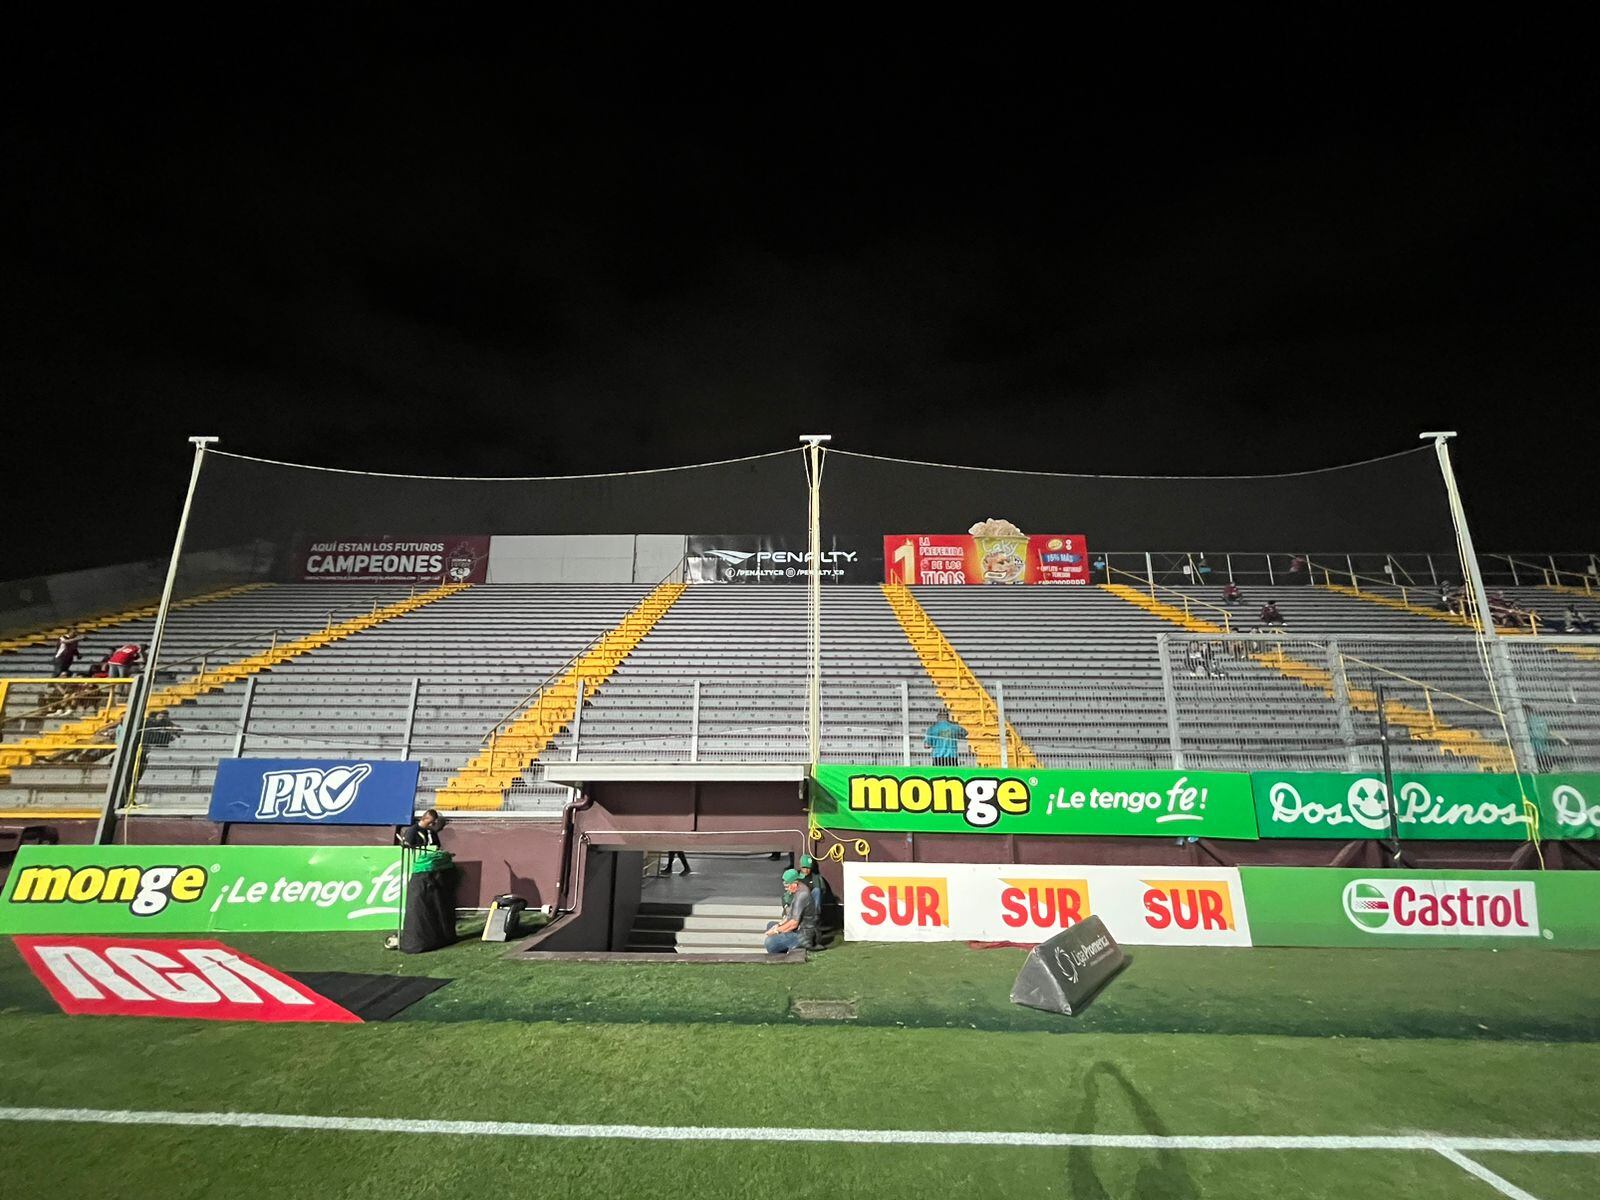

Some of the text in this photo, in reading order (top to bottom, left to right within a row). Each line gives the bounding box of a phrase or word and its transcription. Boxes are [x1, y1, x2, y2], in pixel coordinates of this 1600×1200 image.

[372, 542, 394, 552] LOS
[394, 542, 445, 552] FUTUROS
[919, 536, 931, 546] LA
[919, 547, 964, 556] PREFERIDA
[306, 555, 443, 573] CAMPEONES
[920, 571, 965, 584] TICOS
[931, 561, 962, 570] DE LOS
[256, 764, 371, 819] PRO
[850, 776, 1029, 826] monge
[1089, 789, 1161, 814] tengo
[1269, 782, 1534, 825] Dos Pinos
[12, 864, 208, 916] monge
[271, 877, 363, 908] tengo
[860, 886, 940, 927] SUR
[1001, 887, 1082, 928] SUR
[1393, 885, 1529, 928] Castrol
[1143, 889, 1227, 931] SUR
